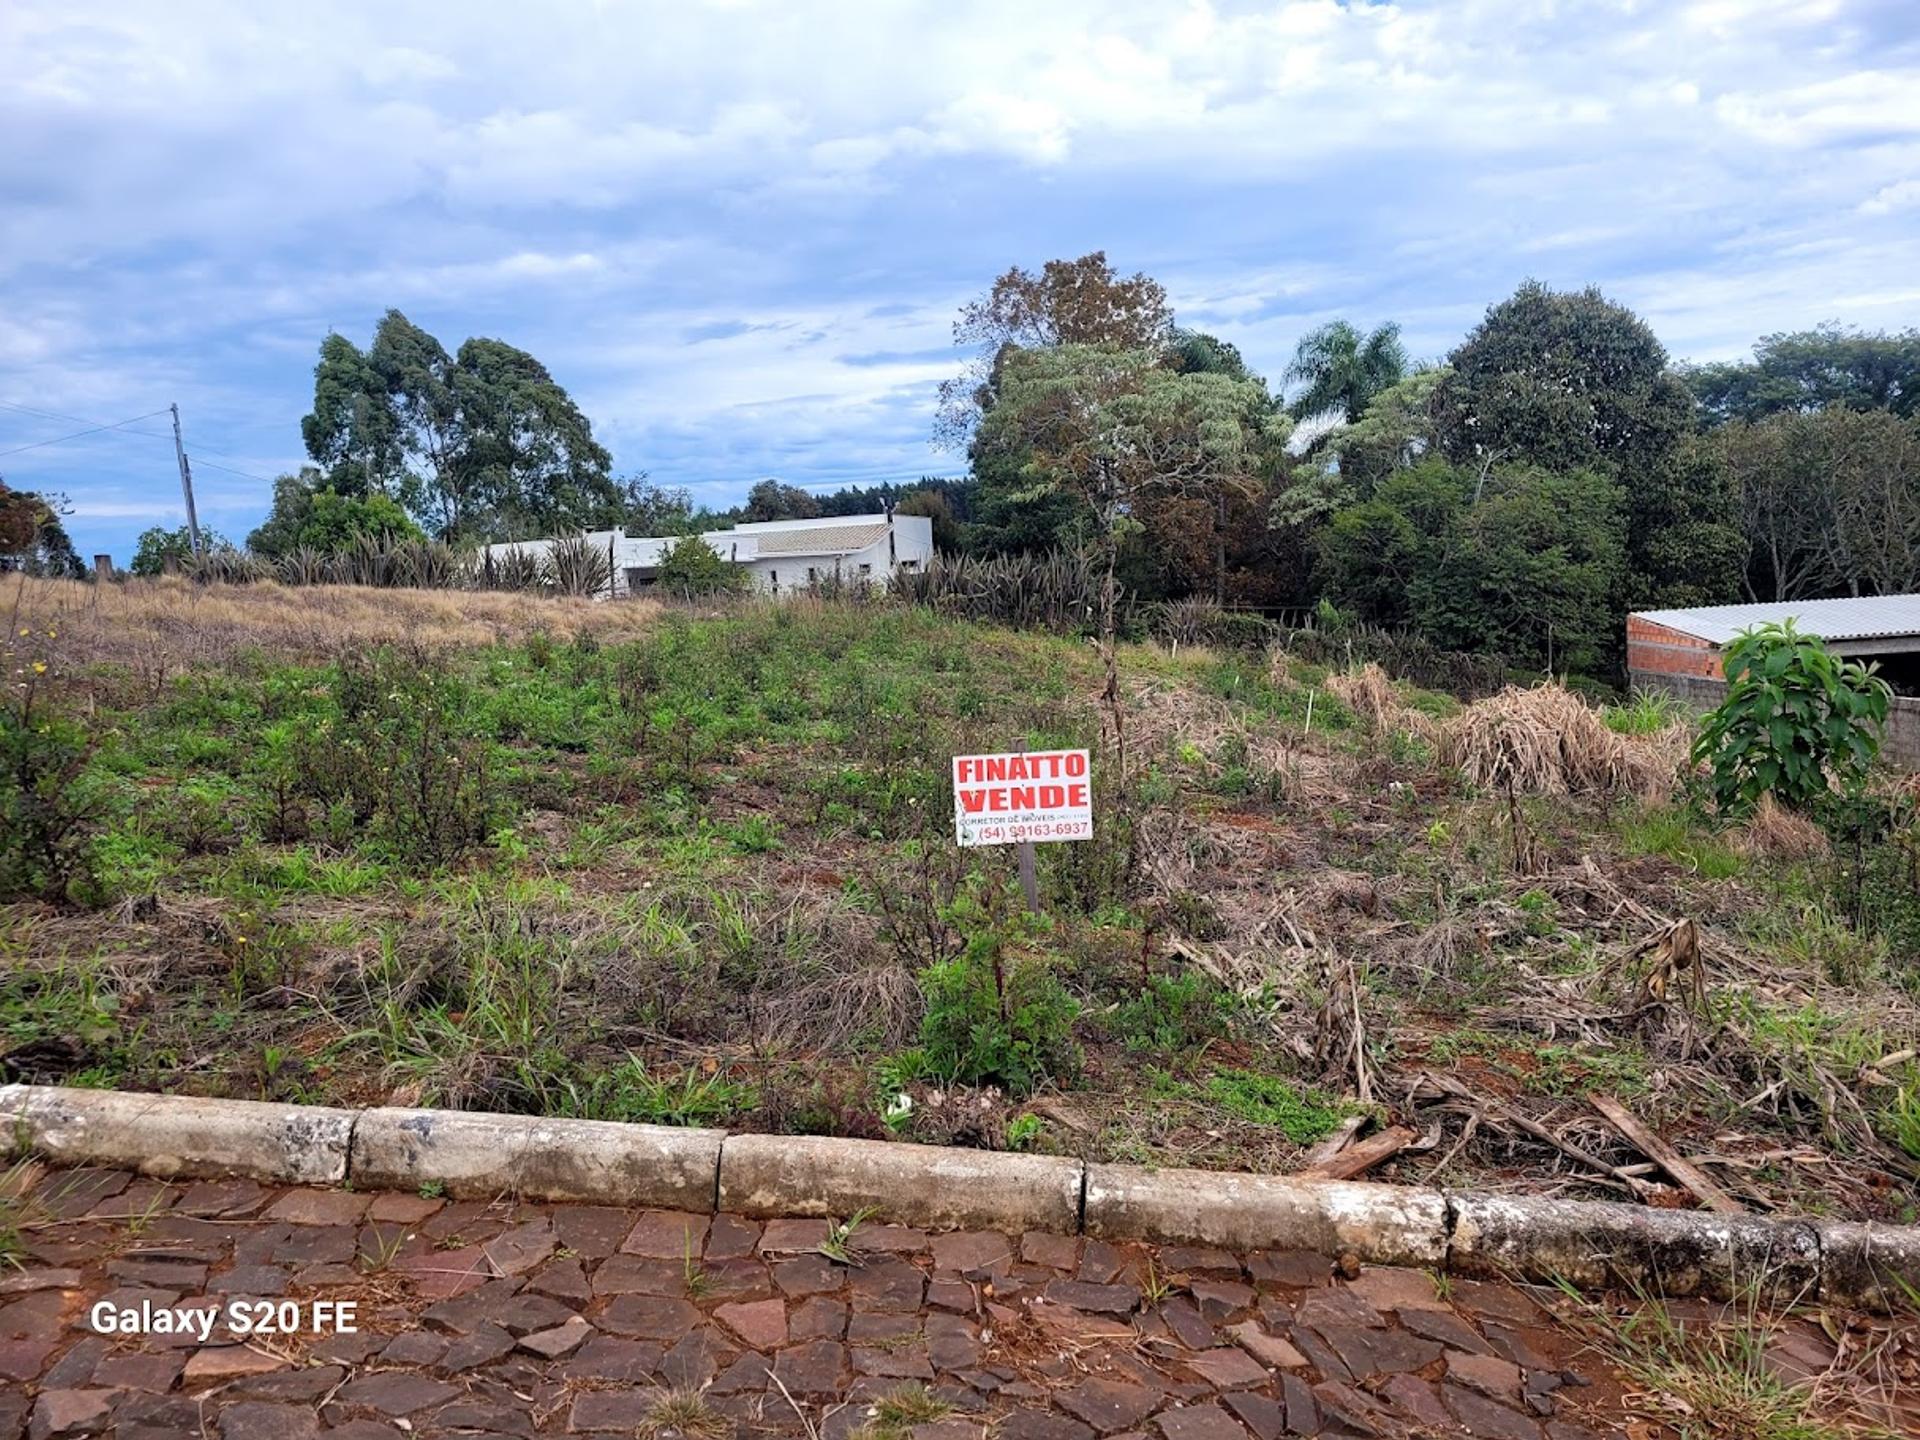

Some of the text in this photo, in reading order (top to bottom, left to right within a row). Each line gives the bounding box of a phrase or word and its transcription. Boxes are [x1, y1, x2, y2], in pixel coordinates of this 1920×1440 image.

[958, 753, 1085, 783] FINATTO
[959, 784, 1088, 813] VENDE
[959, 816, 1006, 826] CORRETOR
[1007, 816, 1019, 824] DE
[978, 822, 1089, 841] (54) 99163-6937
